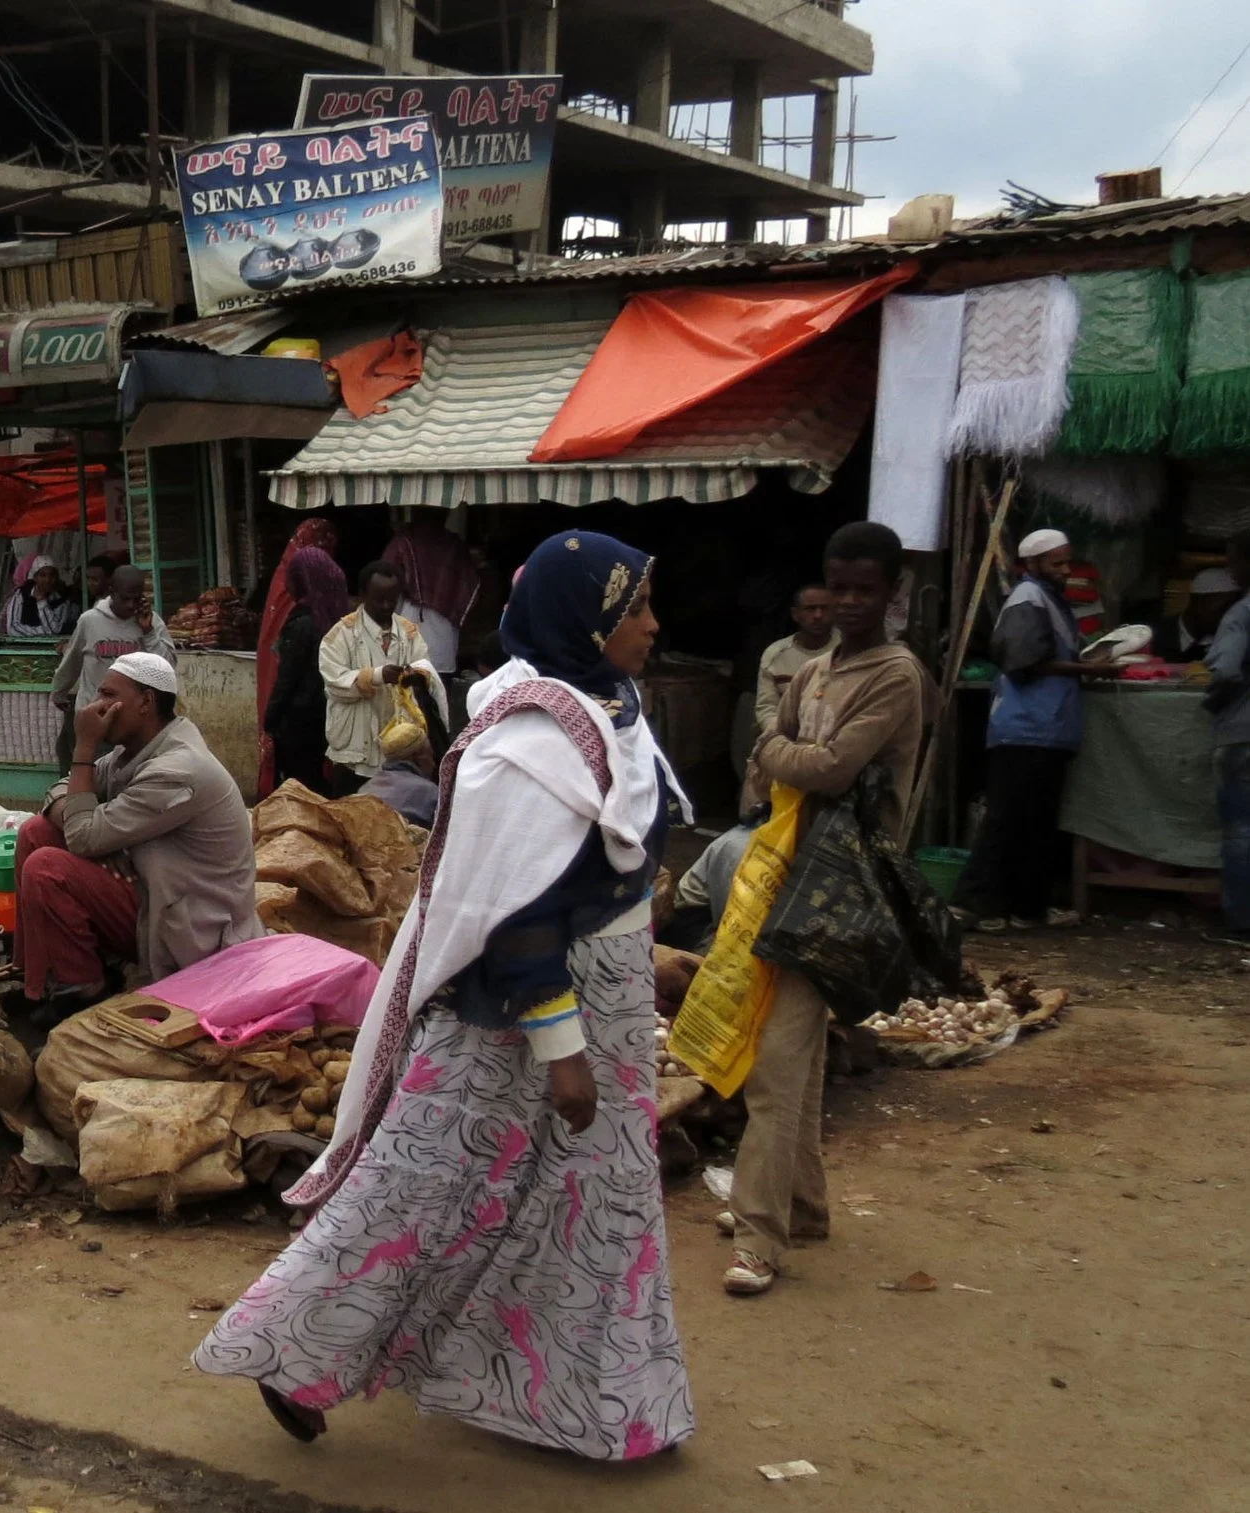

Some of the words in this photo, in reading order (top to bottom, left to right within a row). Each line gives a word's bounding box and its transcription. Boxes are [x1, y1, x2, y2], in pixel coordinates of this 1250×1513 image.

[447, 80, 556, 126] ባልትና
[306, 122, 429, 164] ባልትና
[192, 181, 286, 216] SENAY
[294, 160, 431, 202] BALTENA
[24, 331, 106, 366] 2000
